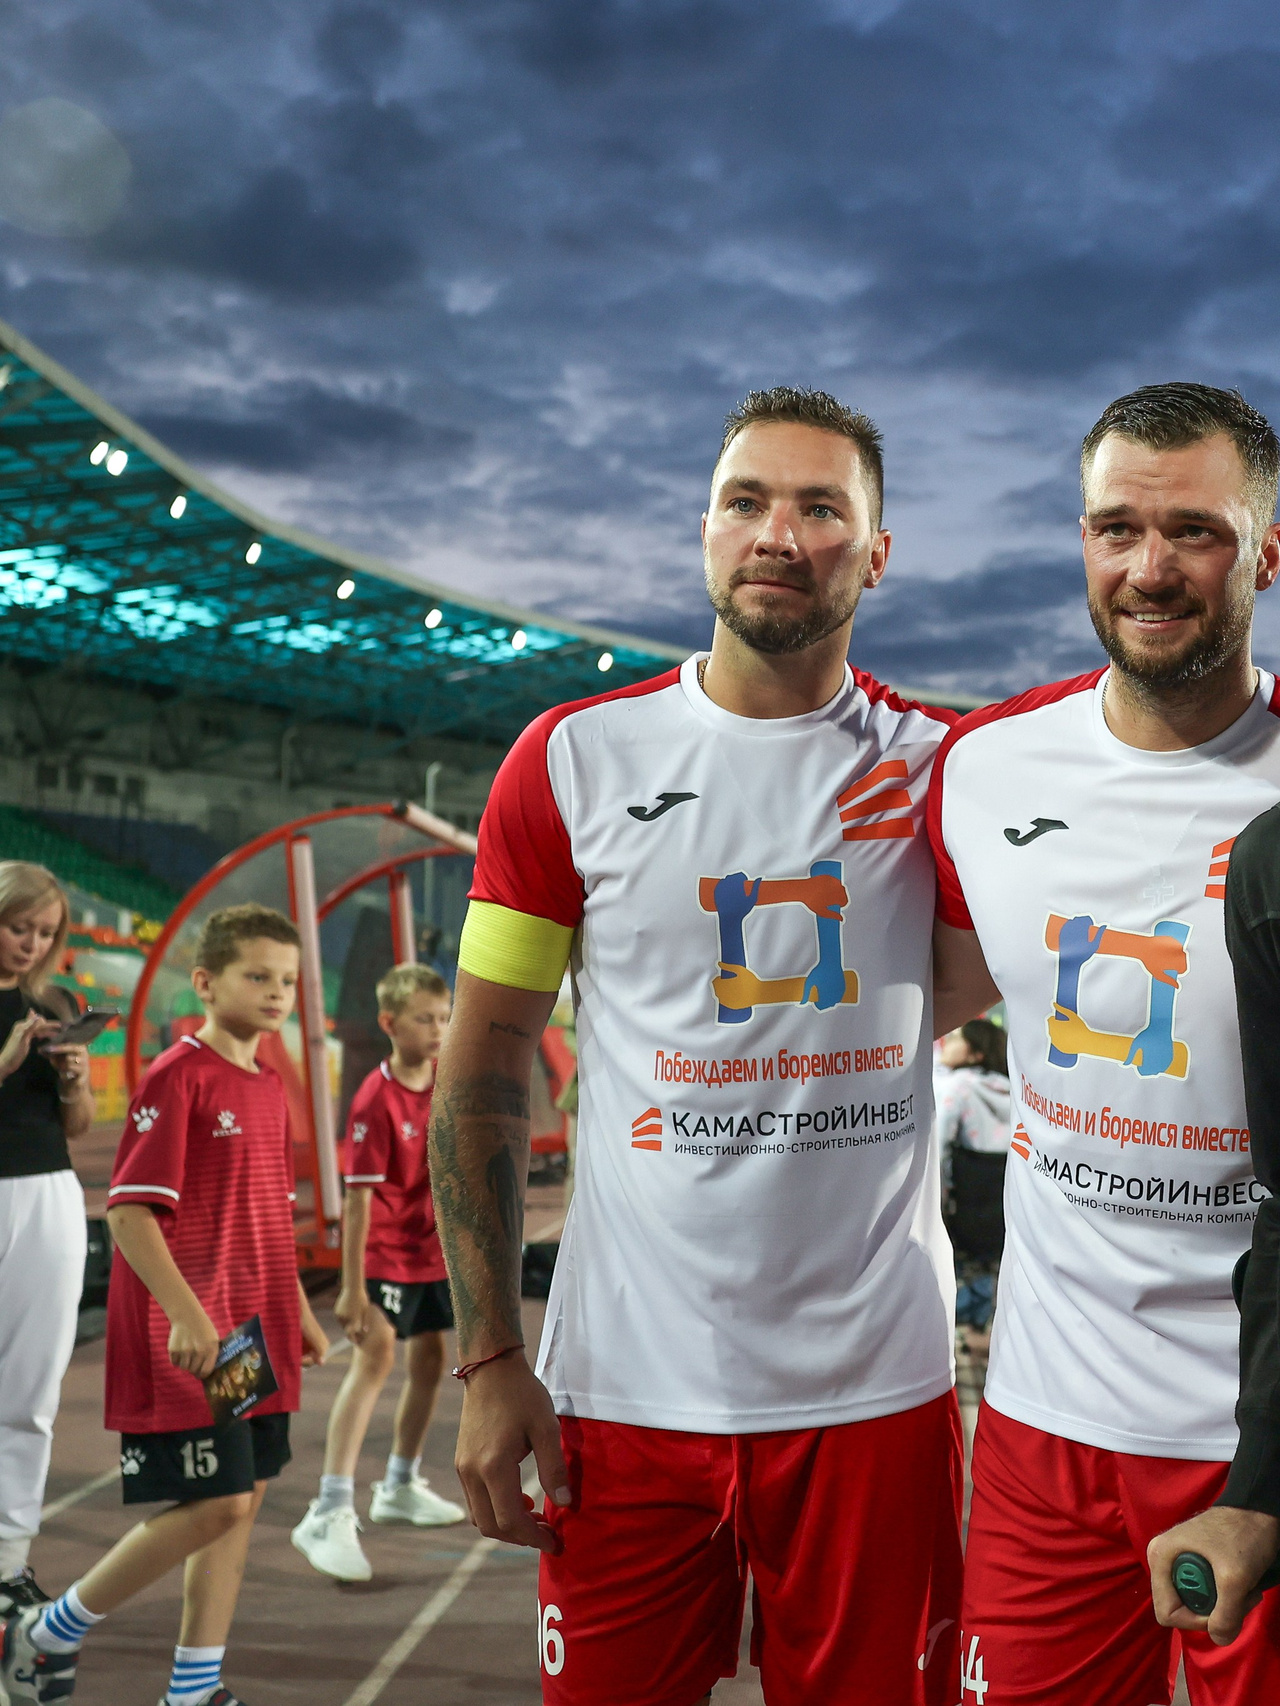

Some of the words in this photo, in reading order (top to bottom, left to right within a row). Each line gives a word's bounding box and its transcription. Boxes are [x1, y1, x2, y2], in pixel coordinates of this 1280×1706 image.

[654, 1049, 758, 1089] Побеждаем
[761, 1057, 774, 1081] и
[778, 1048, 851, 1086] боремся
[854, 1043, 904, 1073] вместе
[674, 1133, 882, 1157] ИНВЕСТИЦИОННО-СТРОИТЕЛЬНАЯ
[1084, 1110, 1097, 1136] и
[1099, 1106, 1178, 1149] боремся
[1182, 1125, 1250, 1152] вместе
[180, 1438, 219, 1480] 15
[537, 1598, 565, 1676] 6
[960, 1629, 989, 1706] 4
